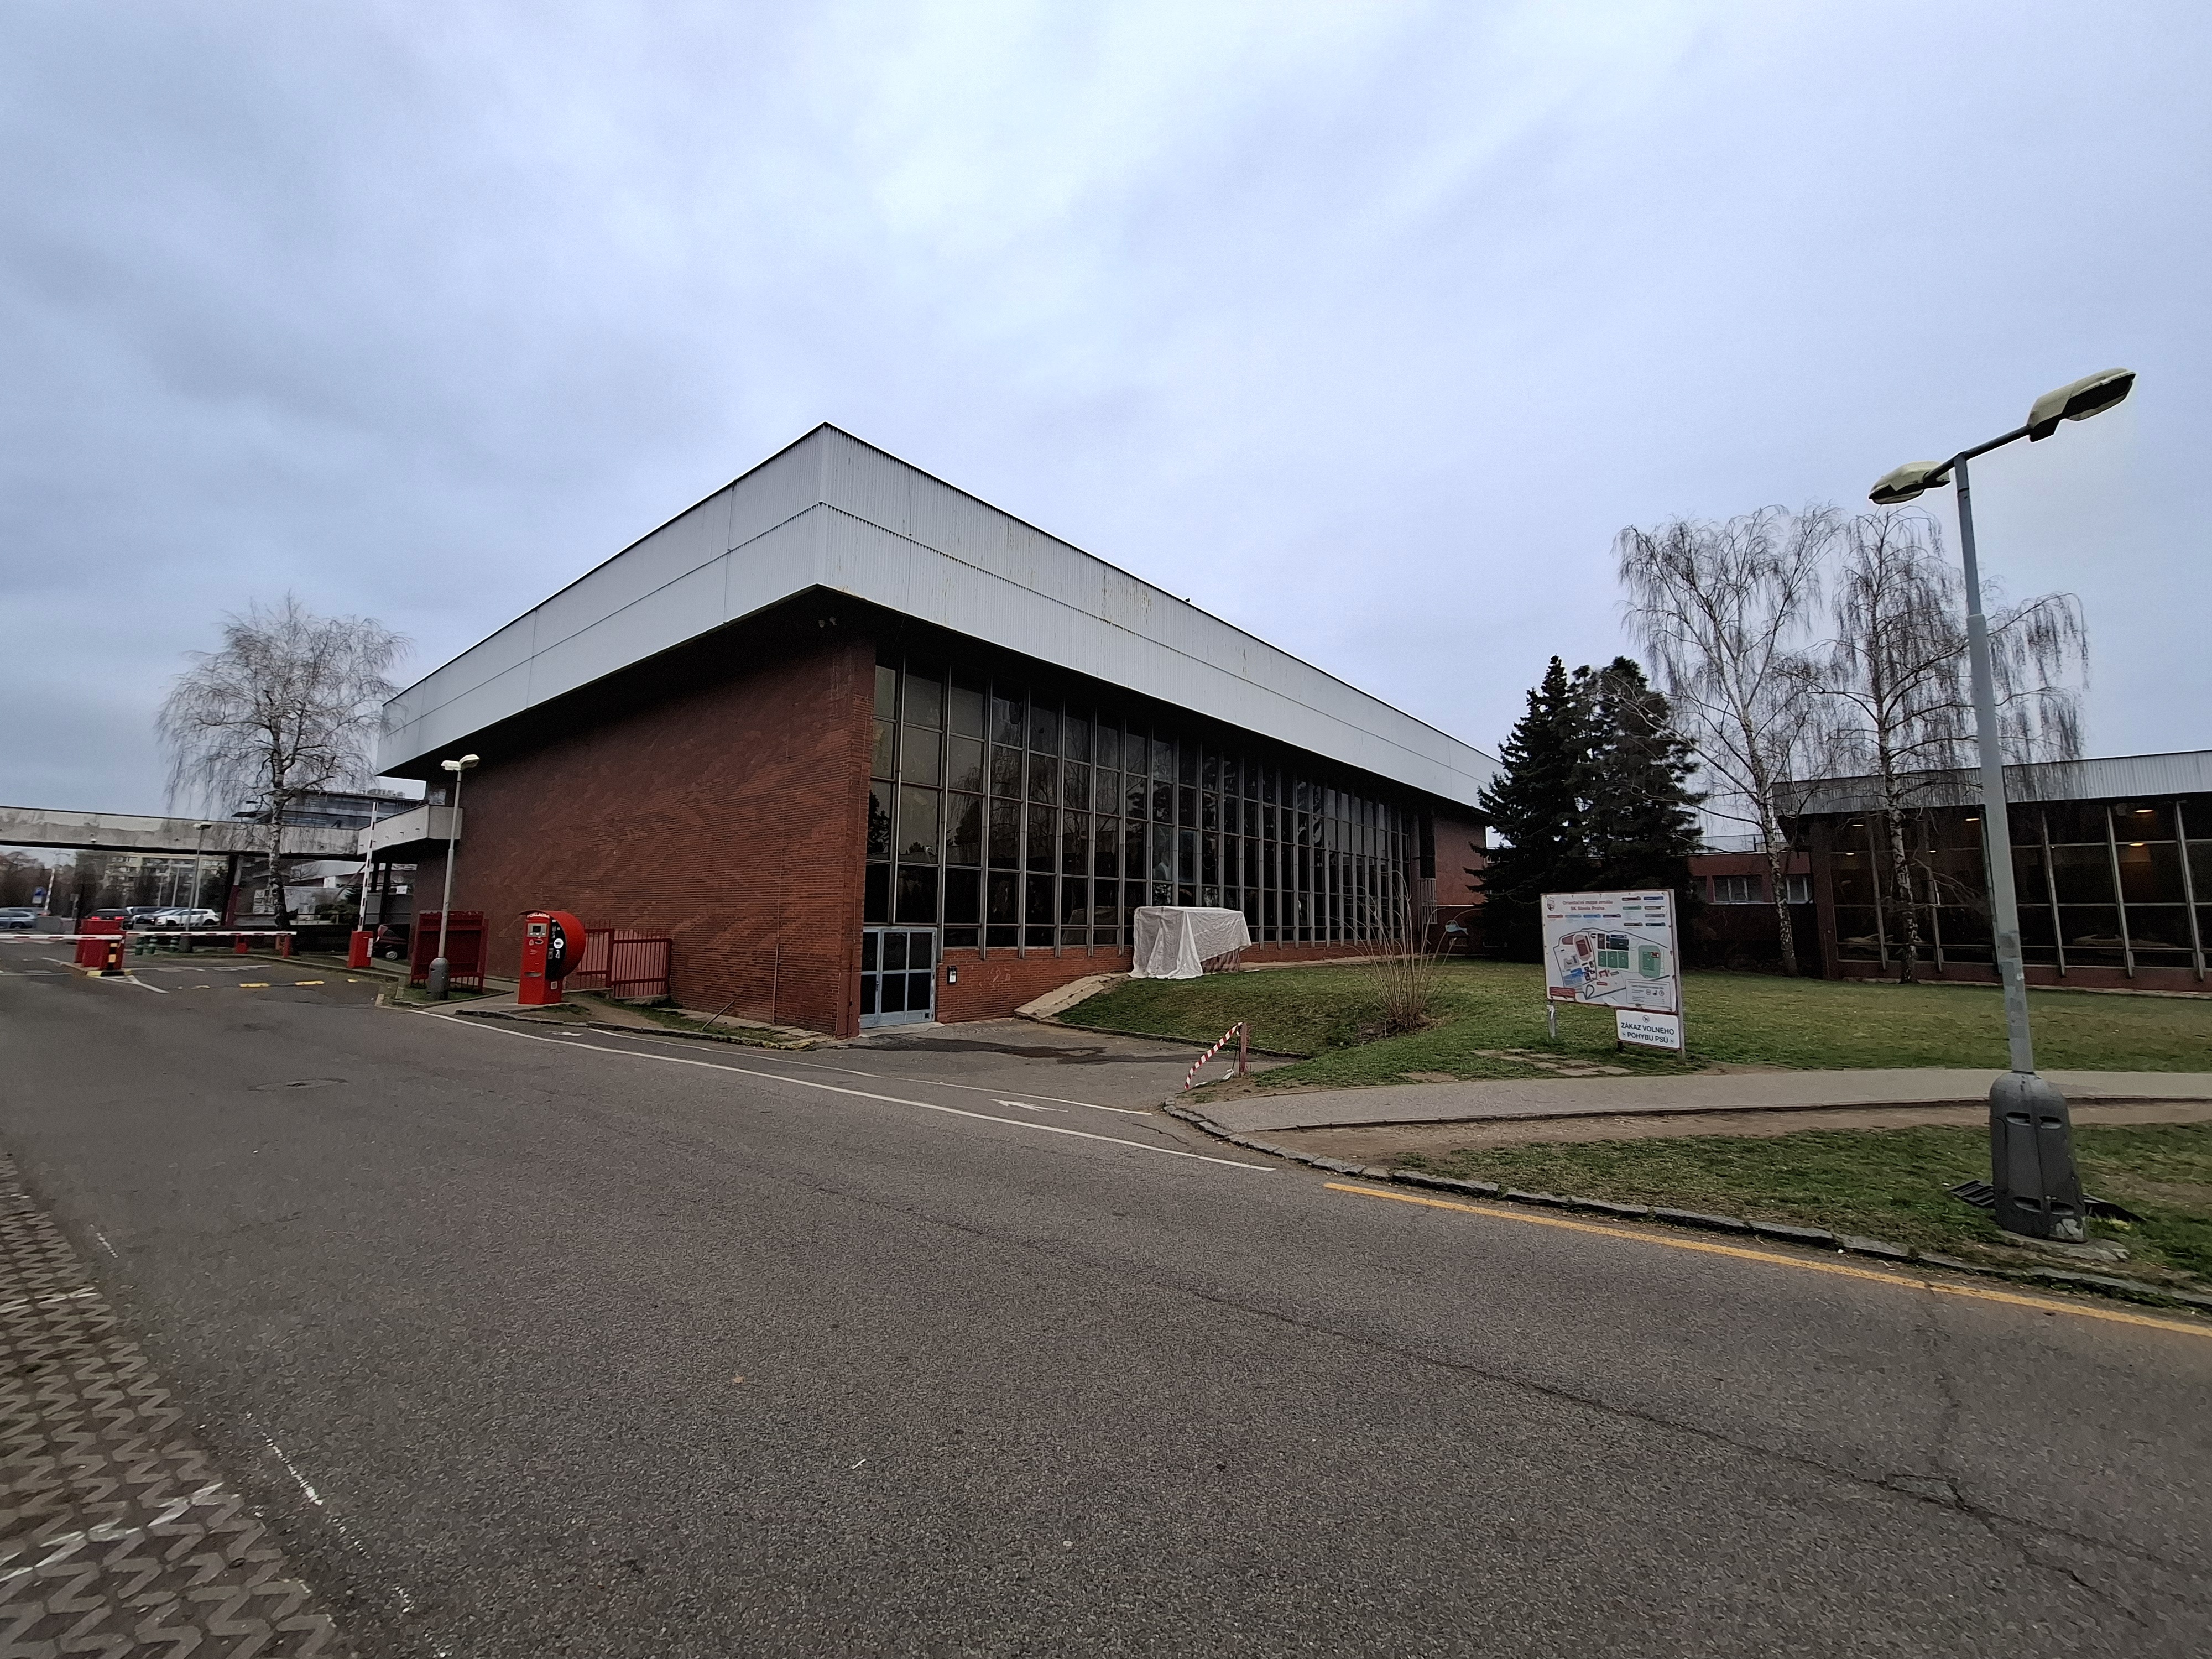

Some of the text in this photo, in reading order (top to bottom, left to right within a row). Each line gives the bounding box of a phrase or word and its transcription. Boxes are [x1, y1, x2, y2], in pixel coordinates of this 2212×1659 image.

[1621, 1022, 1674, 1035] ZÁKAZ VOLNÉHO
[1627, 1032, 1668, 1044] POHYBU PSŮ
